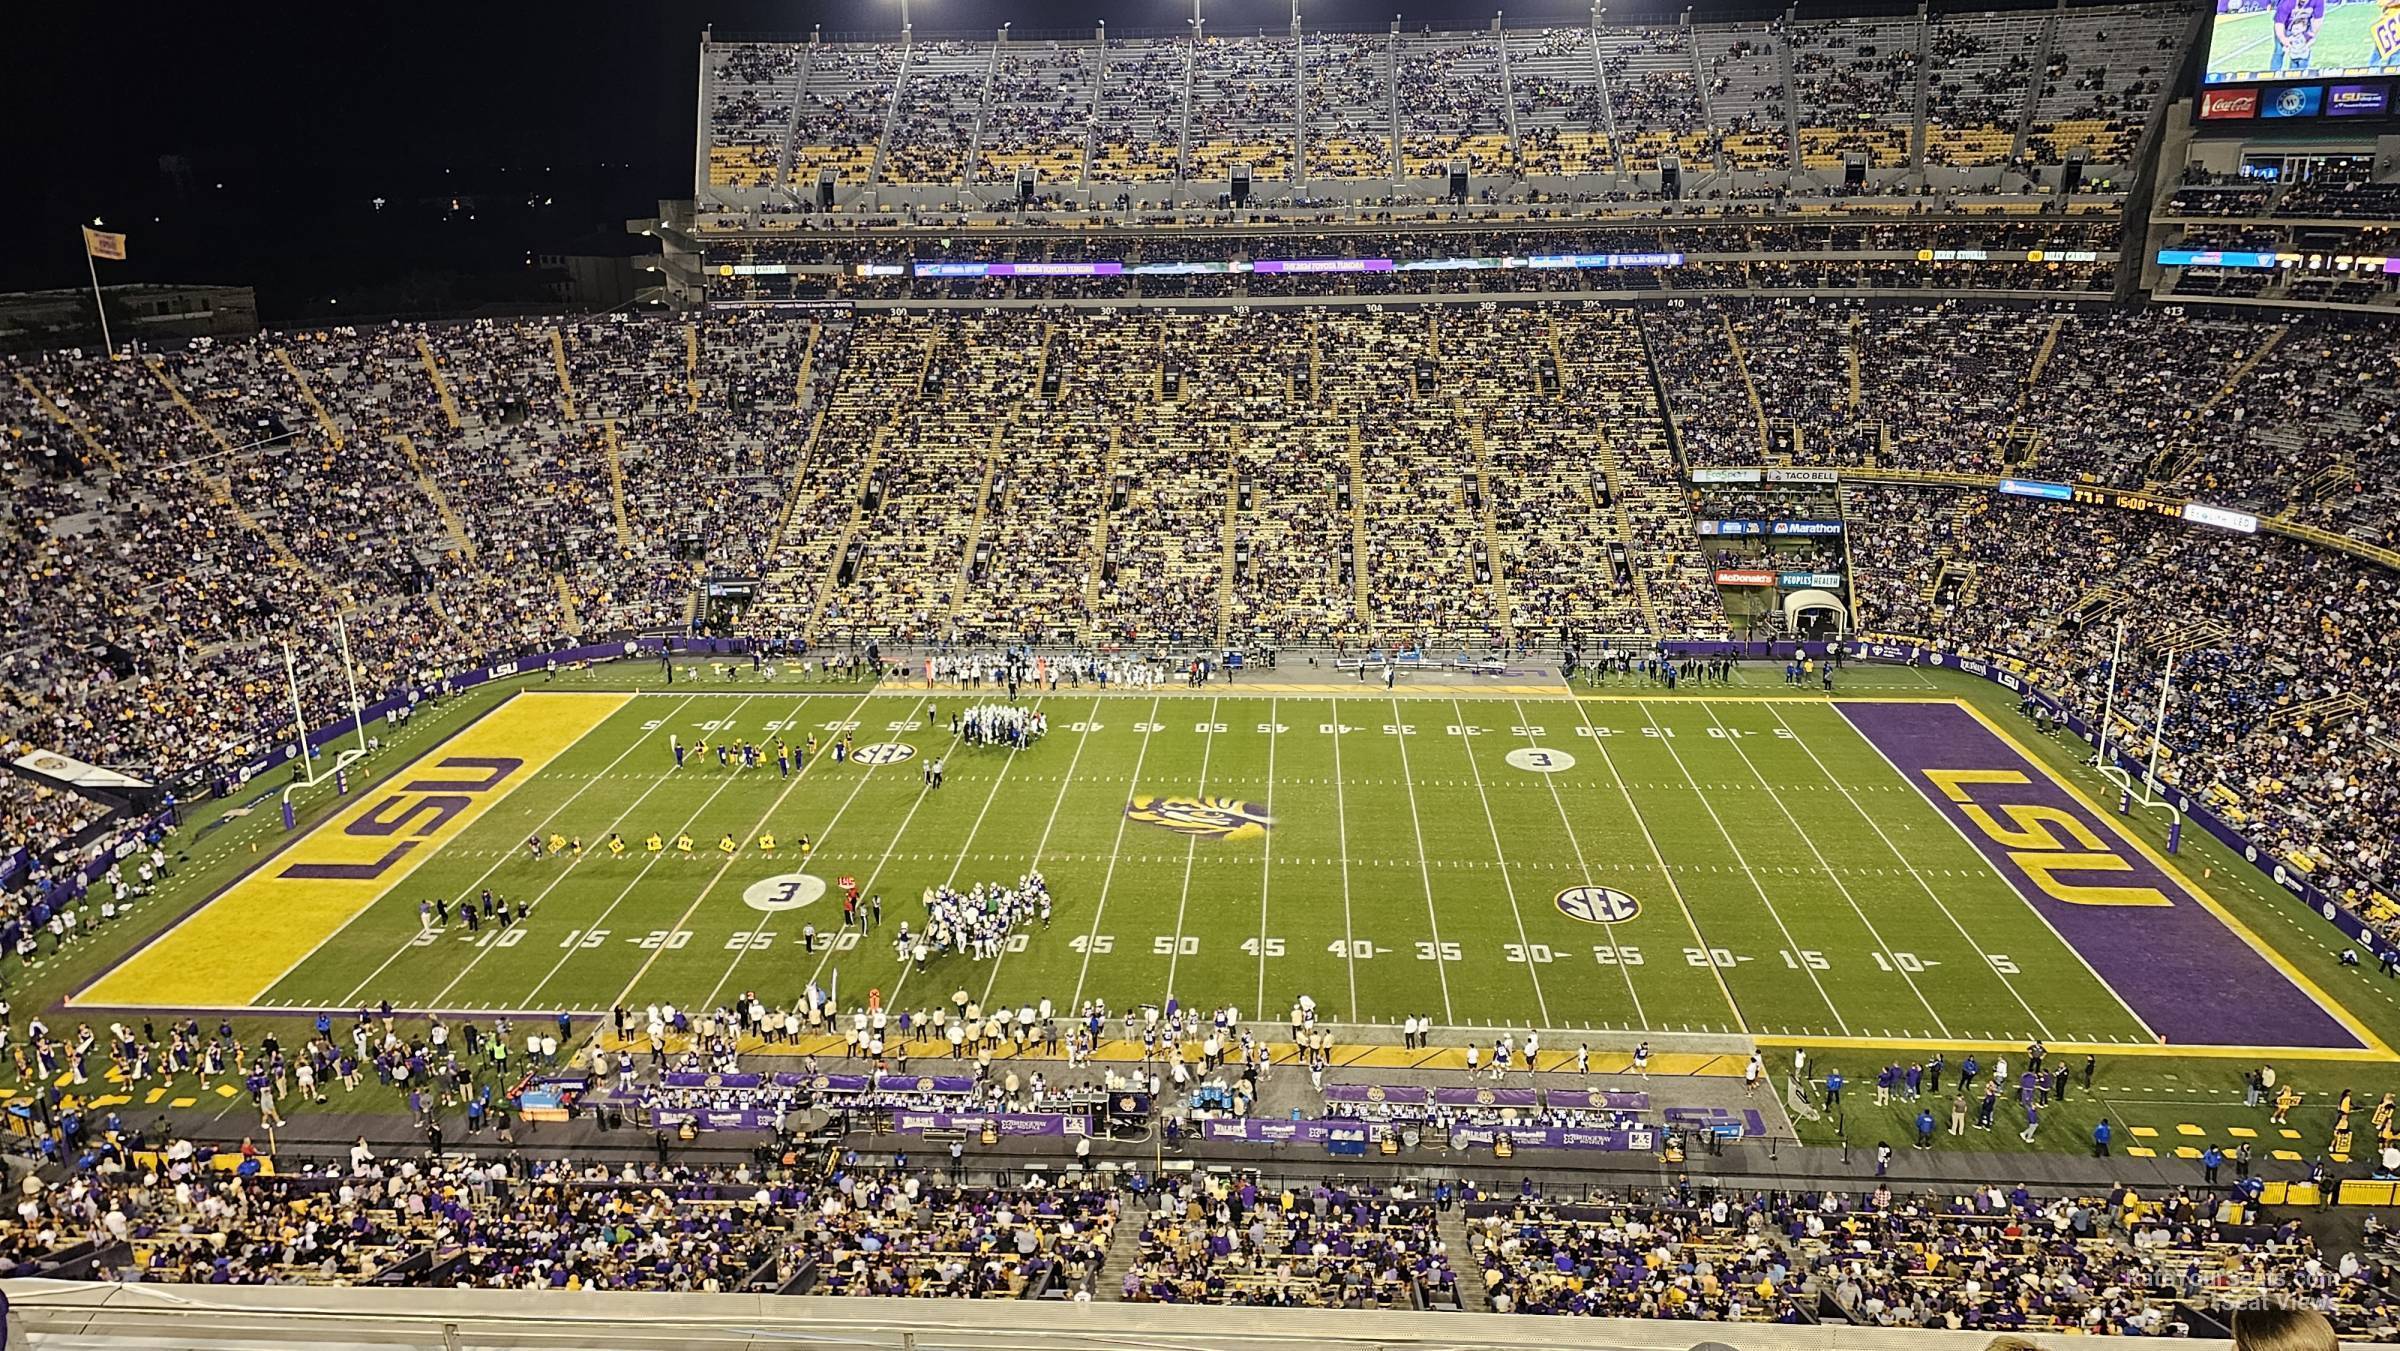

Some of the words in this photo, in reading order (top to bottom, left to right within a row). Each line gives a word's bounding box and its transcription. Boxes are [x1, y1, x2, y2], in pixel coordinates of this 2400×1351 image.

[2212, 97, 2256, 113] Coca-Cola
[2334, 92, 2360, 103] LSU
[890, 308, 908, 316] 300
[984, 307, 1000, 315] 301
[1366, 304, 1383, 312] 304
[1480, 301, 1497, 310] 305
[1786, 472, 1810, 481] TACO
[1812, 472, 1834, 481] BELL
[1789, 522, 1841, 533] Marathon
[1717, 572, 1773, 584] McDonald's
[1813, 575, 1839, 586] HEALTH
[488, 661, 519, 680] LSU
[1998, 671, 2020, 691] LSU
[854, 743, 913, 764] SEC
[276, 756, 524, 880] LSU
[1921, 768, 2176, 907] LSU
[768, 882, 802, 902] 3
[1561, 888, 1636, 921] SEC
[413, 928, 446, 946] 5
[474, 929, 528, 947] 10
[559, 929, 612, 948] 15
[638, 930, 694, 949] 20
[723, 931, 778, 950] 25
[1068, 935, 1116, 954] 45
[1152, 936, 1200, 956] 50
[1240, 938, 1286, 957] 45
[1327, 939, 1373, 959] 40
[1414, 941, 1463, 961] 35
[1503, 943, 1553, 963] 30
[1592, 946, 1645, 965] 25
[1682, 948, 1738, 968] 20
[1779, 949, 1832, 970] 15
[1871, 951, 1926, 973] 10
[1986, 954, 2022, 974] 5
